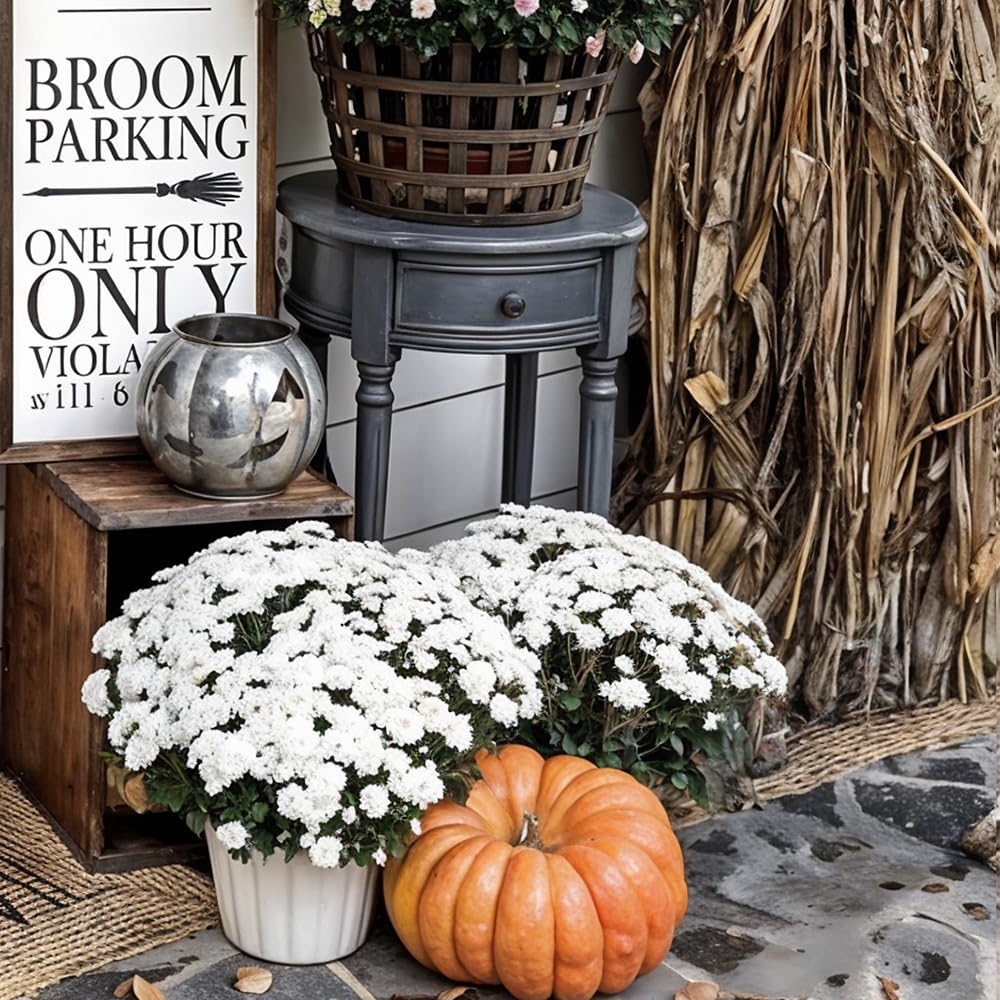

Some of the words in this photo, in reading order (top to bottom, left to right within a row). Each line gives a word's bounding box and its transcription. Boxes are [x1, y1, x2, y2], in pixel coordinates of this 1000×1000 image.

[25, 54, 248, 112] BROOM
[25, 113, 250, 164] PARKING
[24, 228, 113, 266] ONE
[124, 222, 248, 262] HOUR
[29, 340, 157, 379] VIOLA
